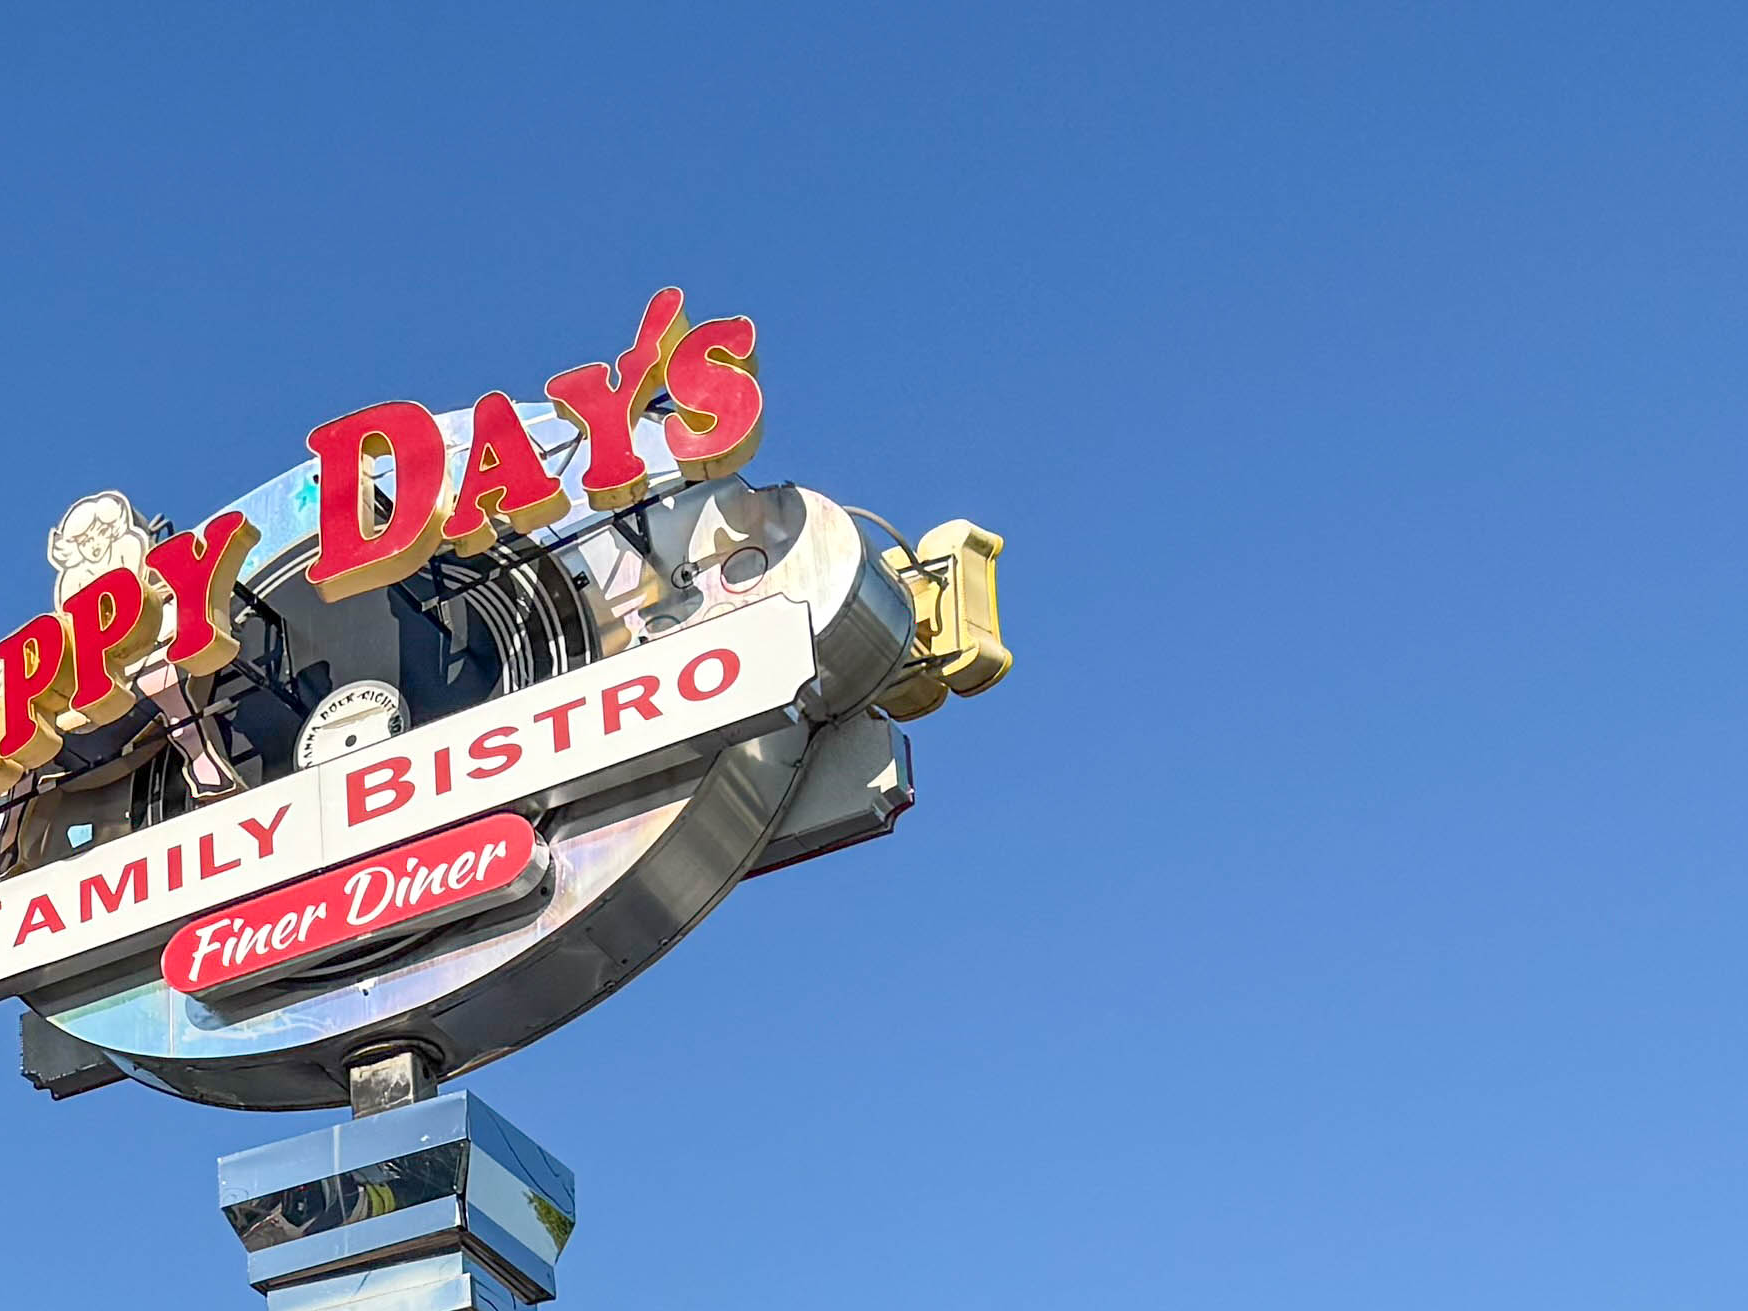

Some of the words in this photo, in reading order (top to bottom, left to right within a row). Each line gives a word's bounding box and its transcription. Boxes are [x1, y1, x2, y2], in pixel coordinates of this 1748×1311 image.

[345, 647, 742, 828] BISTRO
[187, 900, 328, 983] Finer
[343, 838, 509, 927] Diner
